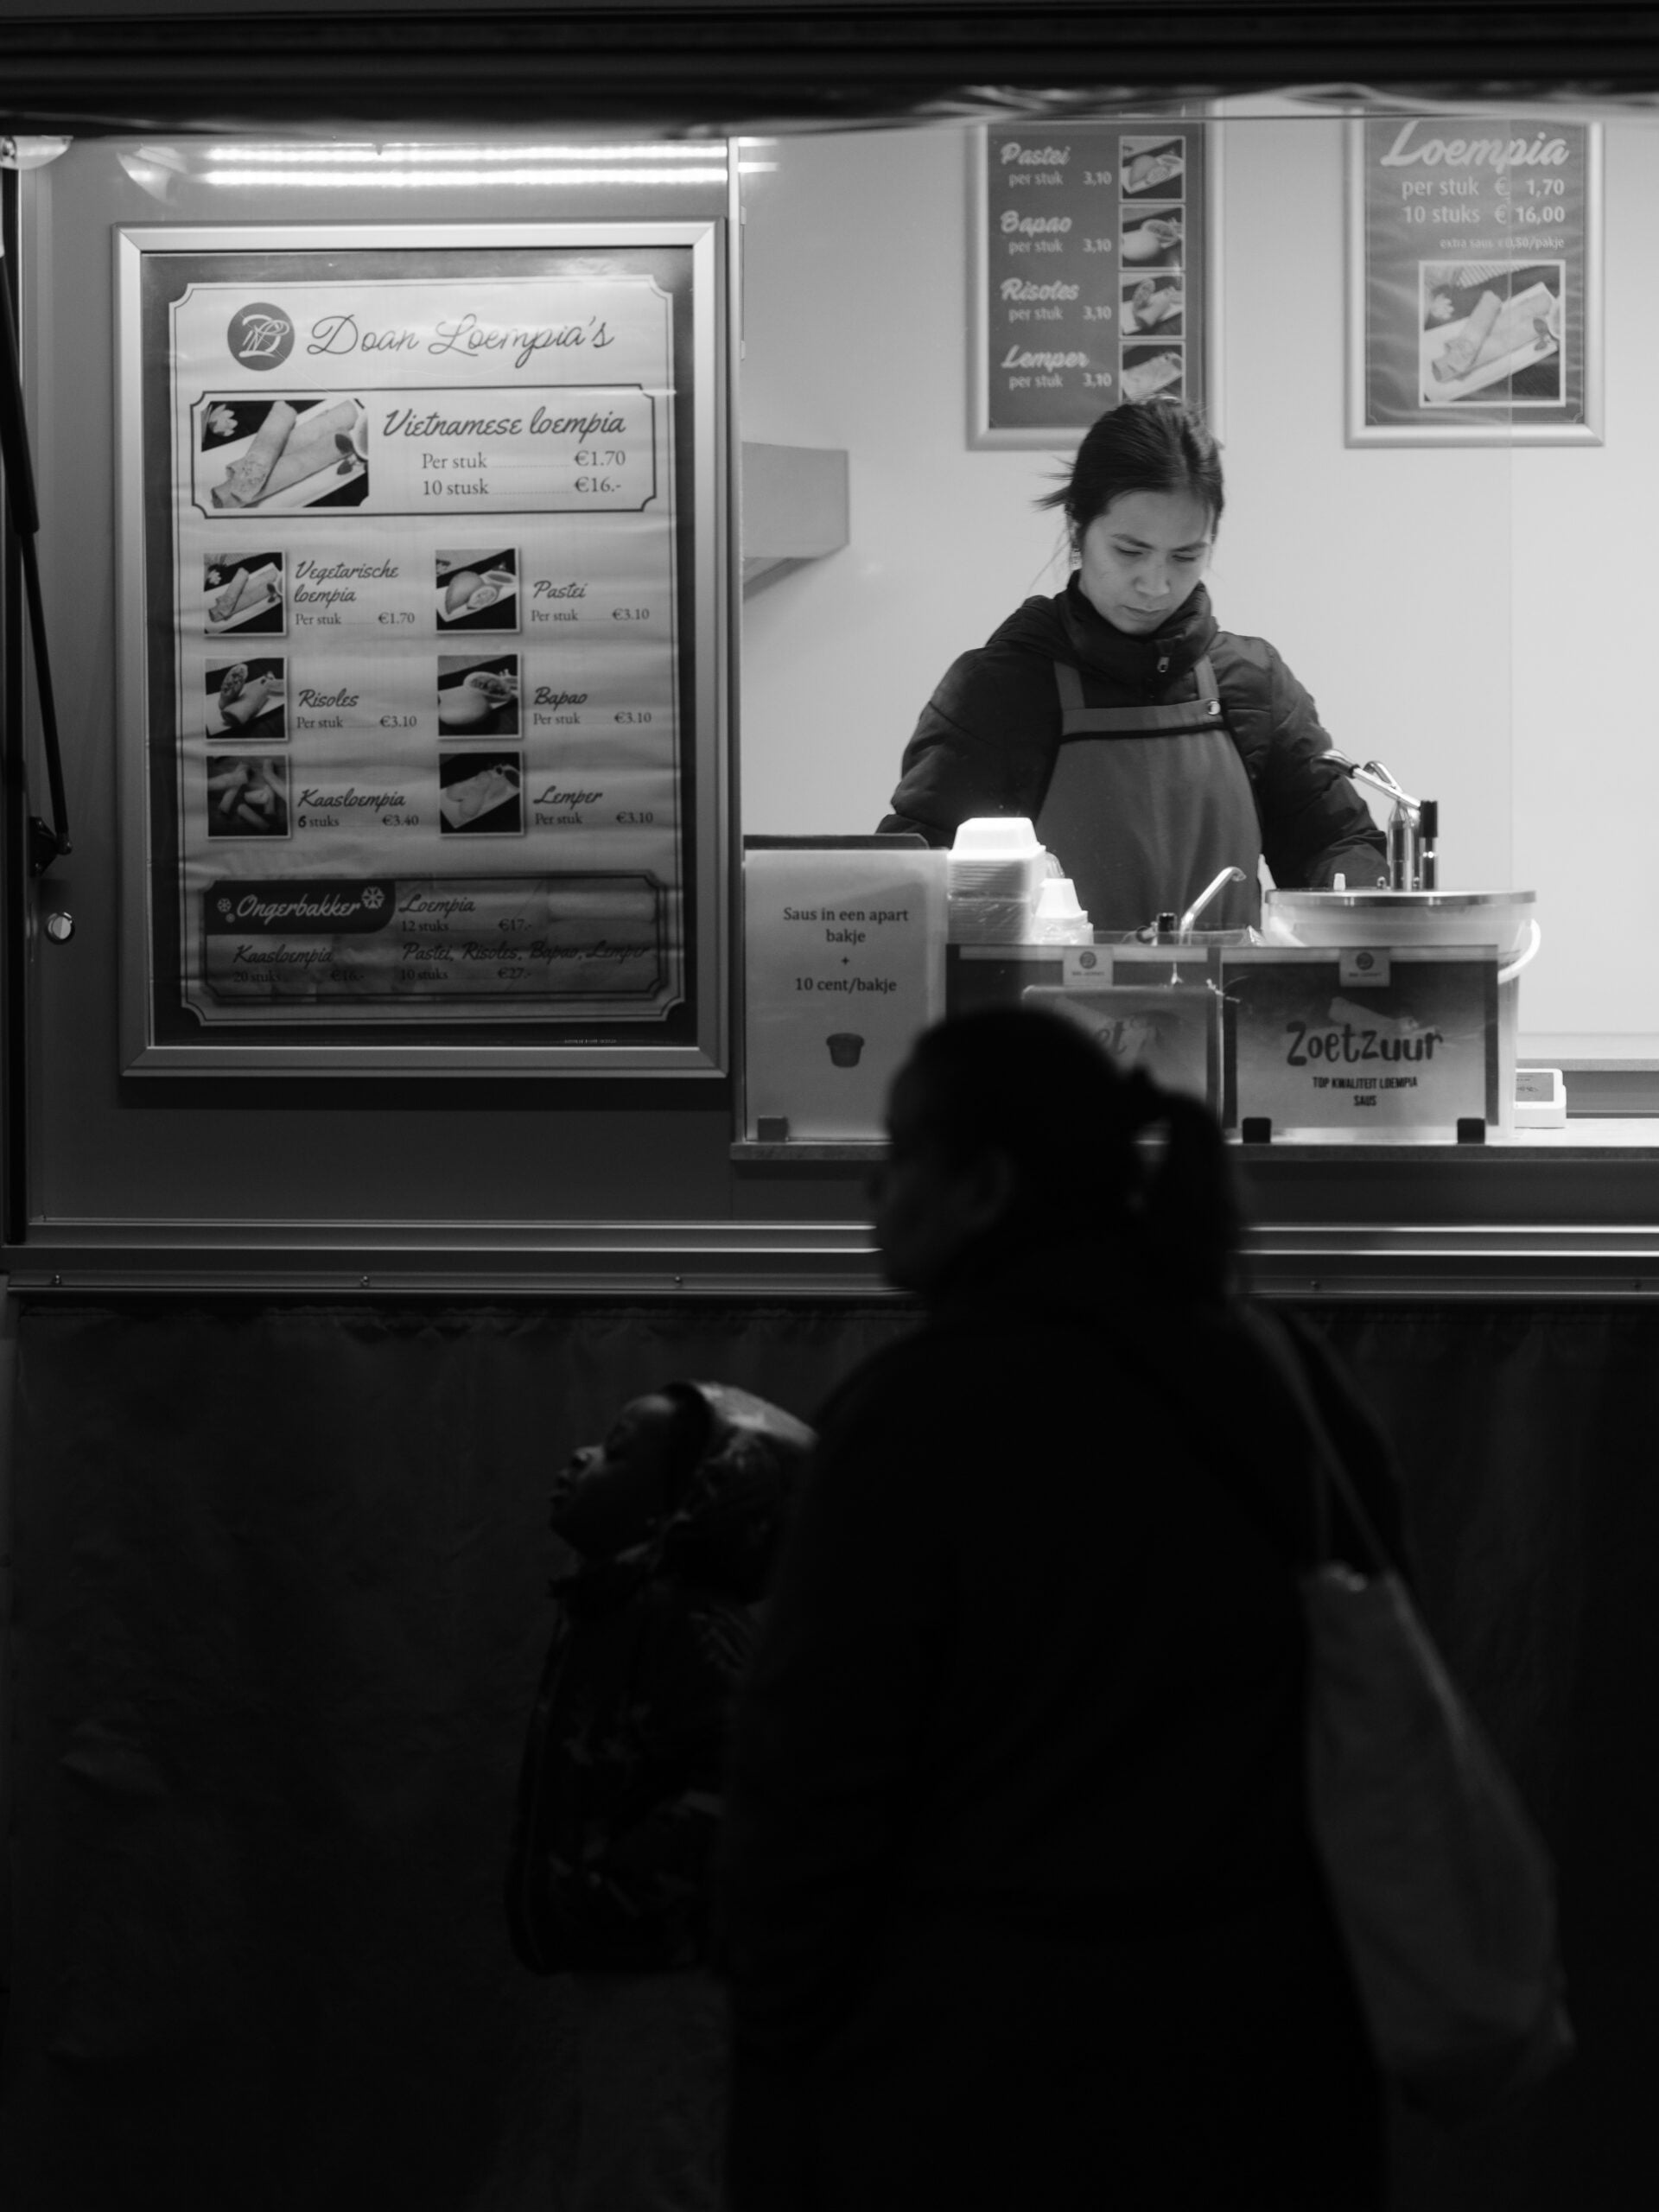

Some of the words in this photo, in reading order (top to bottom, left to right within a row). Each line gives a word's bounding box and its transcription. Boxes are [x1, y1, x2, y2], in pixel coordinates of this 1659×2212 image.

[1000, 141, 1071, 166] Pastei
[1379, 120, 1570, 175] Loempia
[1008, 173, 1032, 188] per
[1033, 171, 1064, 186] stuk
[1082, 170, 1113, 188] 3,10
[1401, 180, 1433, 200] per
[1439, 176, 1480, 196] stuk
[1493, 178, 1509, 198] €
[1525, 178, 1566, 199] 1,70
[1000, 209, 1073, 238] Bapao
[1403, 206, 1427, 225] 10
[1431, 204, 1481, 225] stuks
[1493, 206, 1509, 225] €
[1514, 206, 1566, 226] 16,00
[1008, 241, 1032, 256] per
[1033, 238, 1064, 253] stuk
[1082, 238, 1113, 255] 3,10
[1439, 237, 1467, 250] extra
[1000, 276, 1080, 302] Risoles
[1008, 308, 1032, 323] per
[1033, 306, 1064, 321] stuk
[1082, 305, 1113, 321] 3,10
[306, 314, 420, 355] Doan
[429, 313, 615, 369] Loempia's
[1001, 344, 1090, 373] Lemper
[1008, 376, 1032, 391] per
[1033, 373, 1064, 388] stuk
[1082, 372, 1113, 389] 3,10
[382, 409, 523, 437] Vietnamese
[529, 405, 627, 443] loempia
[422, 452, 449, 471] Per
[454, 451, 488, 470] stuk
[574, 449, 626, 467] €1.70
[423, 480, 442, 497] 10
[574, 478, 622, 495] €16.-
[294, 560, 399, 586] Vegetarische
[294, 586, 357, 608] loempia
[532, 580, 588, 600] Pastei
[295, 612, 315, 626] Per
[316, 611, 342, 626] stuk
[378, 610, 416, 626] €1.70
[531, 608, 550, 623] Per
[552, 607, 579, 622] stuk
[611, 607, 650, 621] €3.10
[298, 688, 360, 709] Risoles
[533, 686, 588, 709] Bapao
[296, 715, 316, 730] Per
[318, 715, 344, 729] stuk
[379, 714, 417, 728] €3.10
[532, 712, 552, 727] Per
[554, 711, 581, 726] stuk
[613, 710, 652, 725] €3.10
[297, 787, 406, 811] Kaasloempia
[533, 785, 603, 808] Lemper
[297, 814, 307, 829] 6
[308, 814, 340, 829] stuks
[382, 813, 419, 828] €3.40
[534, 811, 554, 826] Per
[556, 810, 583, 825] stuk
[615, 810, 654, 824] €3.10
[236, 893, 361, 925] Ongerbakker
[397, 893, 476, 918] Loempia
[401, 920, 416, 932] 12
[418, 919, 450, 932] stuks
[783, 906, 817, 923] Saus
[820, 906, 836, 922] in
[839, 909, 866, 923] een
[869, 908, 909, 927] apart
[825, 927, 867, 945] bakje
[232, 944, 334, 969] Kaasloempia
[401, 941, 454, 963] Pastei,
[461, 940, 524, 962] Risoles,
[529, 941, 582, 963] Bapao,
[586, 939, 652, 964] Lemper
[232, 971, 249, 983] 20
[250, 970, 282, 982] stuks
[400, 969, 416, 981] 10
[417, 968, 448, 981] stuks
[795, 976, 814, 992] 10
[816, 976, 898, 995] cent/bakje
[1286, 1020, 1445, 1067] Zoetzuur
[1312, 1076, 1331, 1090] TOP
[1332, 1077, 1378, 1090] KWALITEIT
[1379, 1076, 1419, 1090] LOEMPIA
[1353, 1094, 1378, 1107] SAUS
